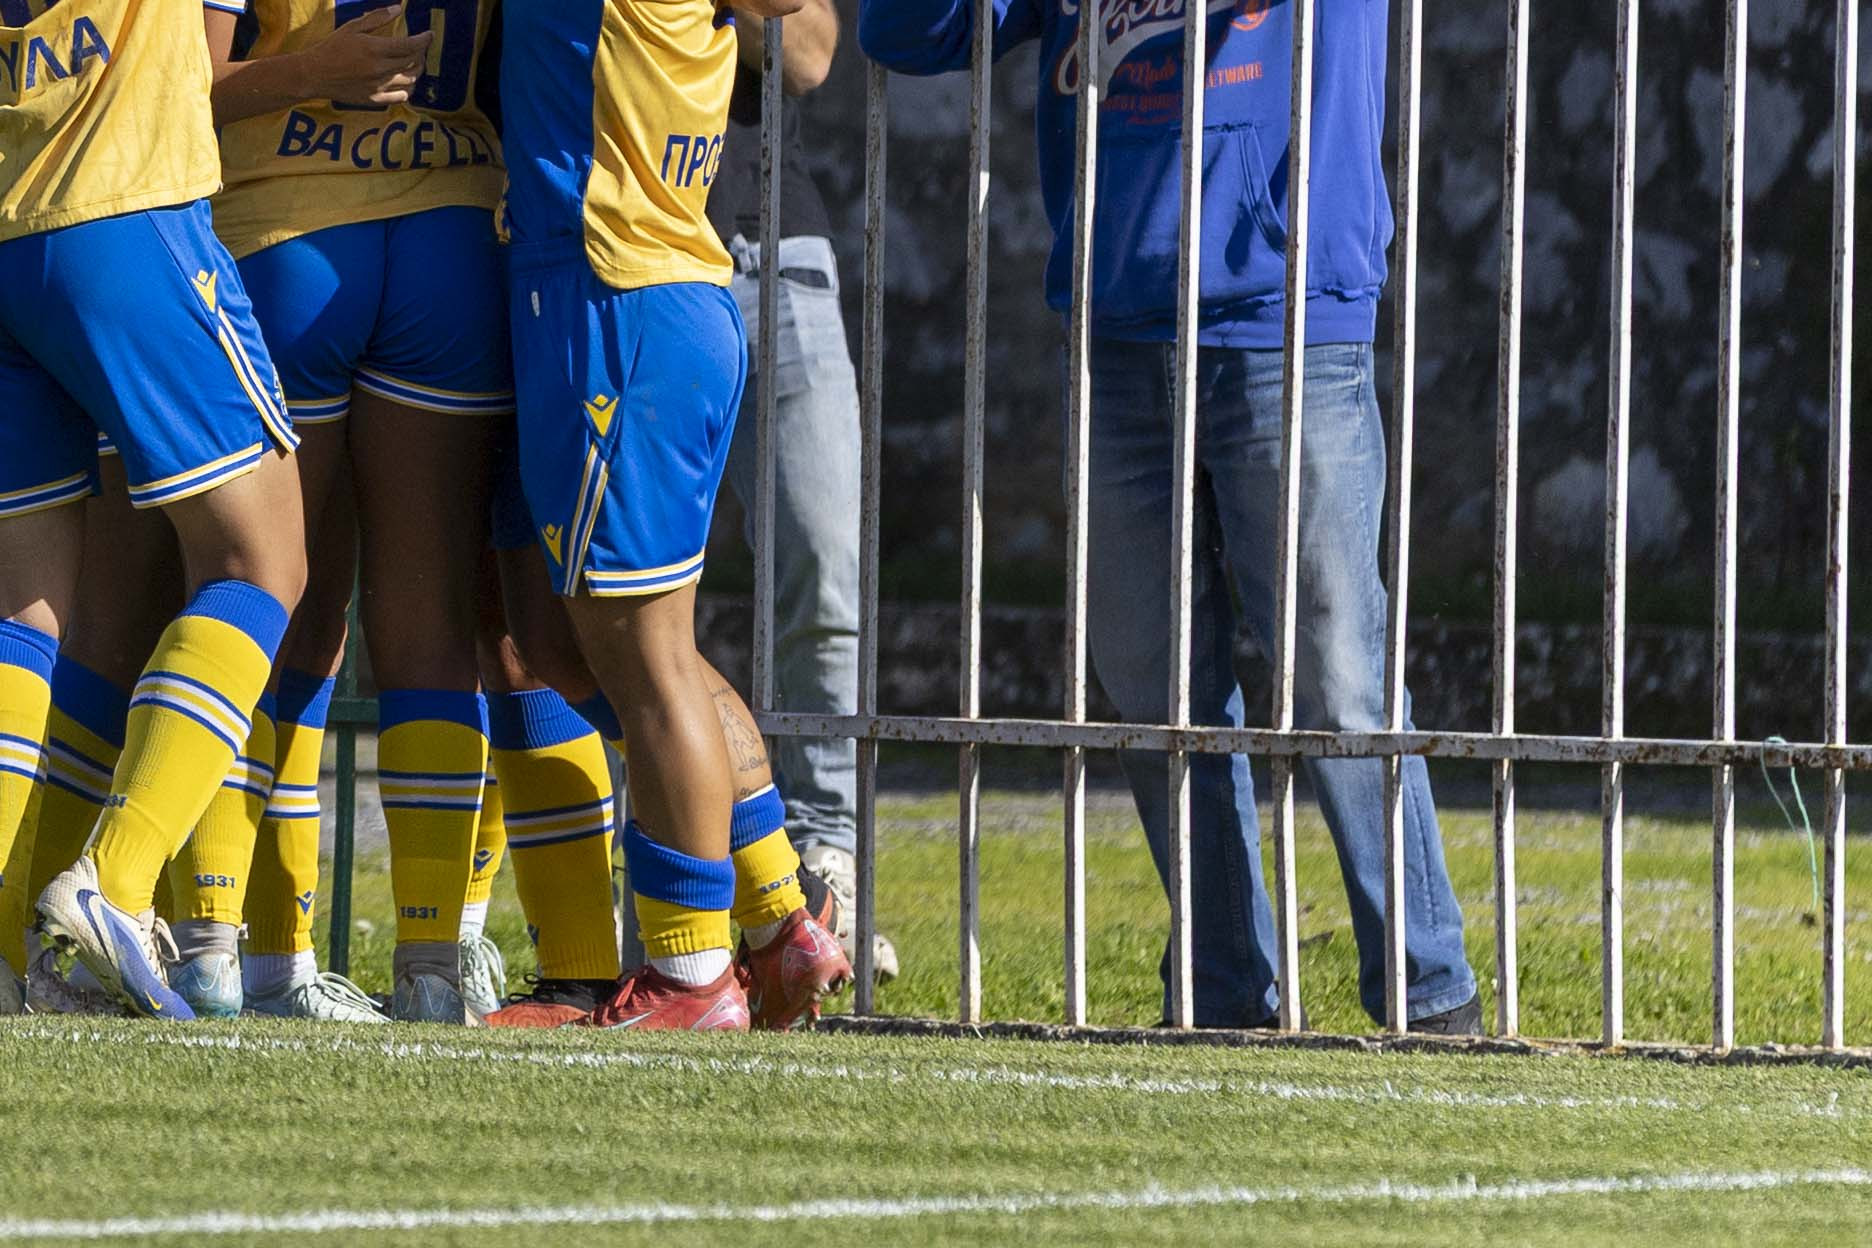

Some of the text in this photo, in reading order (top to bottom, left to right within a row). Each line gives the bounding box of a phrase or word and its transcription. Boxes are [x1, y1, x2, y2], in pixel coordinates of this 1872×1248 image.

[660, 133, 727, 188] ΠΡΟ
[194, 873, 235, 889] 1931
[399, 905, 438, 920] 1931
